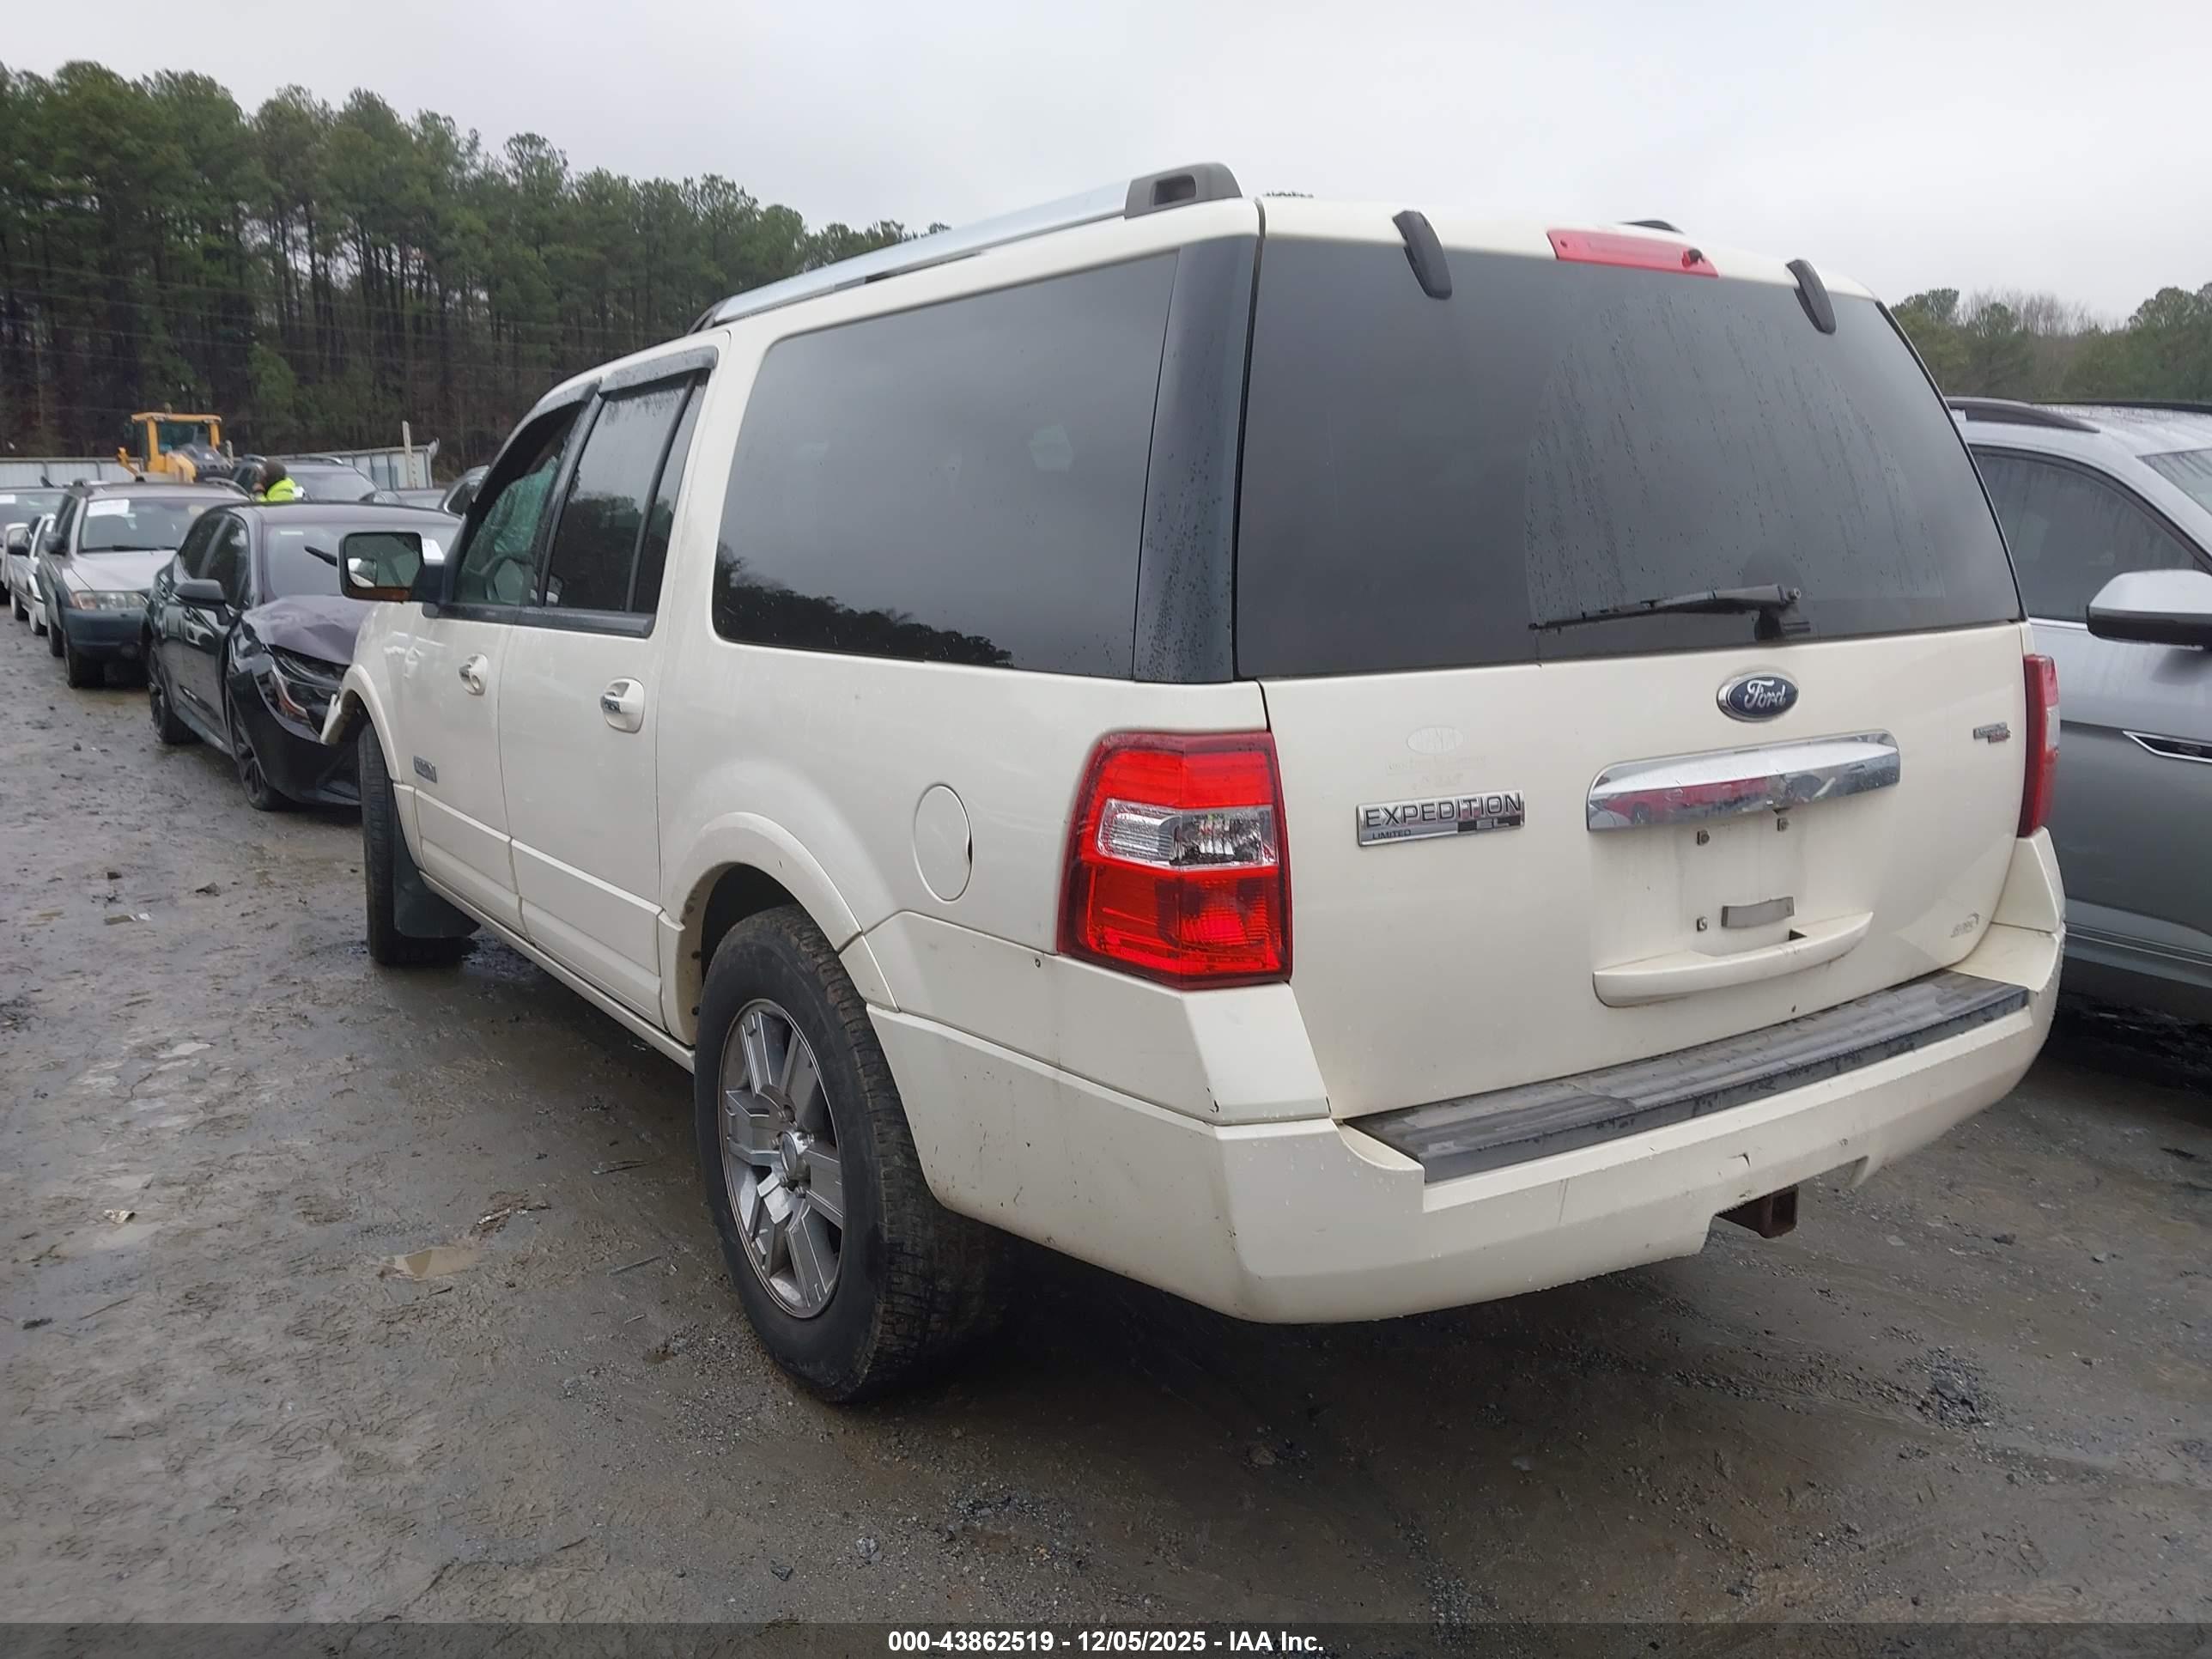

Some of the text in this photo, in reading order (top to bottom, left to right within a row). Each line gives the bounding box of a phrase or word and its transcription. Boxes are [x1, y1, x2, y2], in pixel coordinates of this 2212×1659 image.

[1744, 679, 1786, 708] Ford
[1365, 793, 1522, 828] EXPEDITION
[1372, 828, 1412, 841] LIMITED
